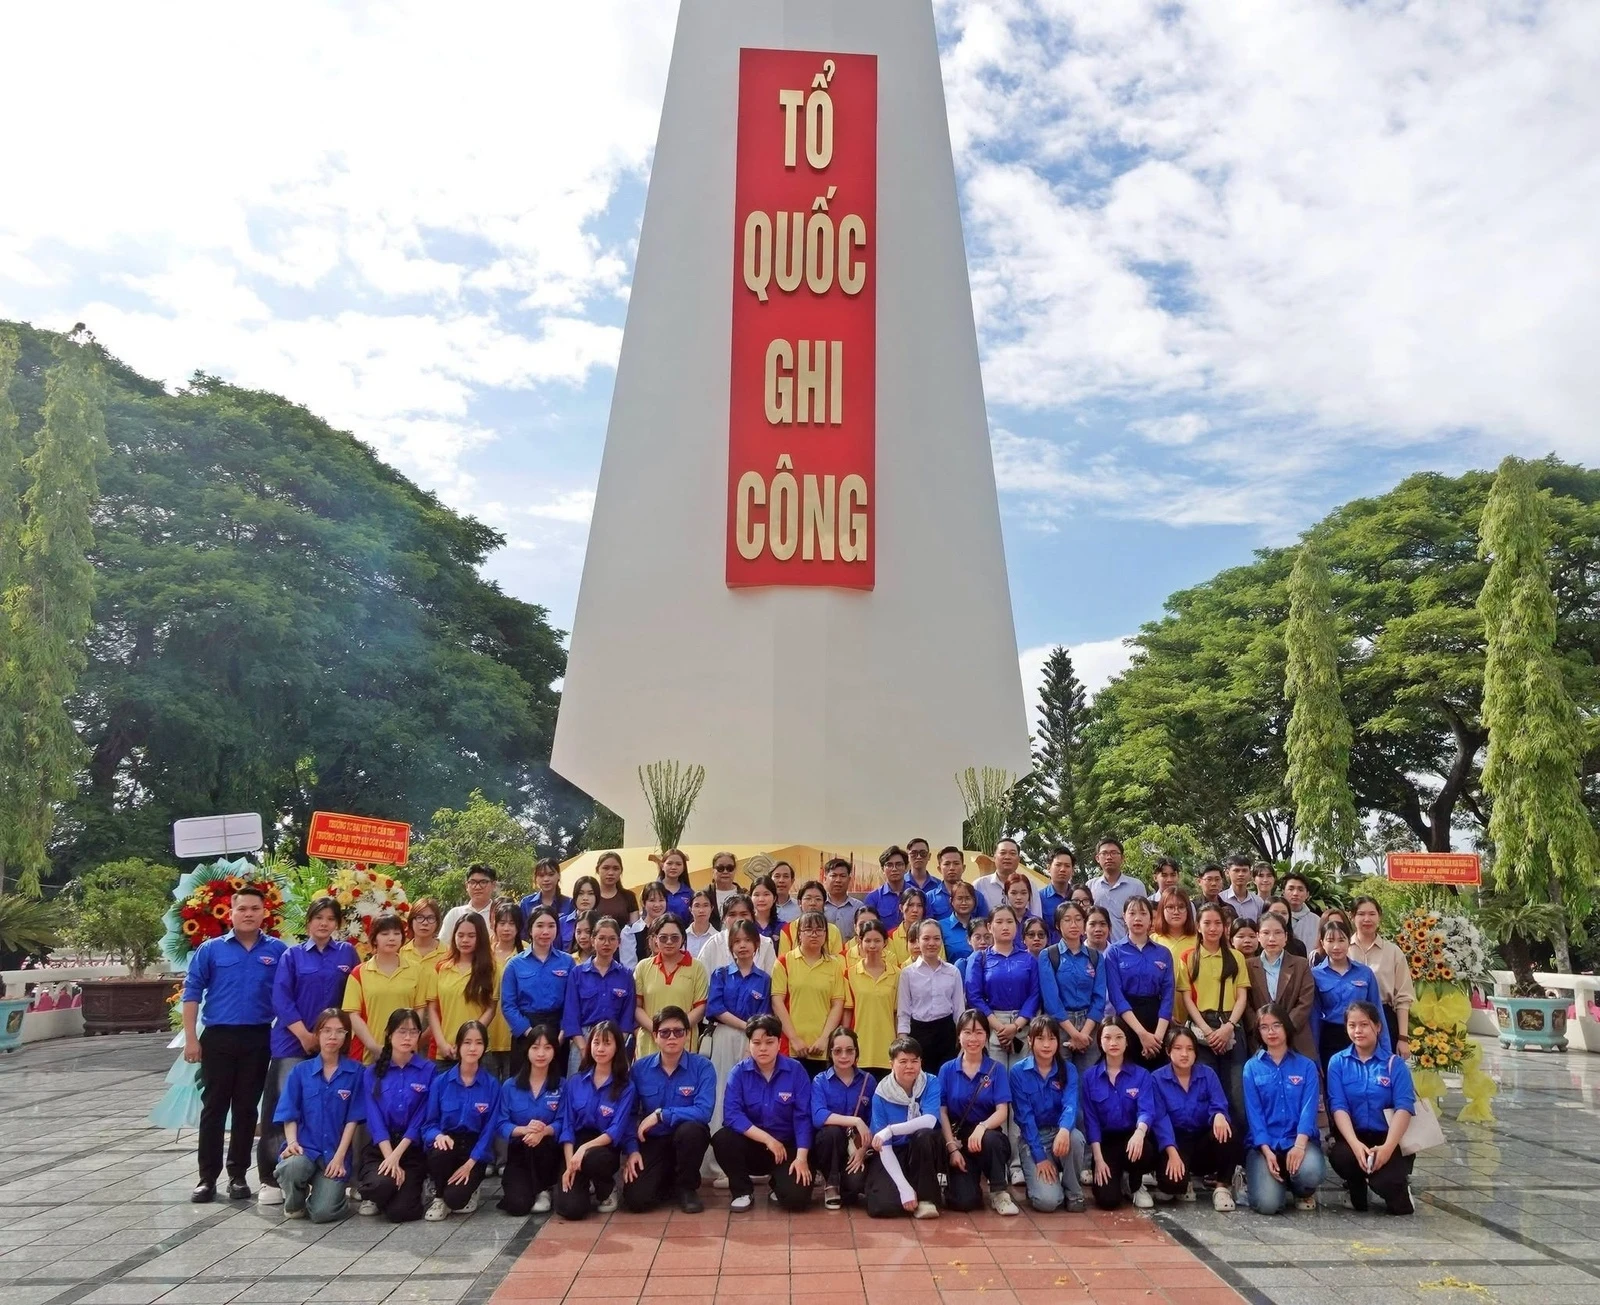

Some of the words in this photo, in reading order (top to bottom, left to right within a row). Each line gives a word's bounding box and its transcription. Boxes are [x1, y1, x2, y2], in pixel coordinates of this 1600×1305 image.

[779, 59, 836, 169] TỔ
[743, 185, 866, 302] QUỐC
[764, 338, 843, 425] GHI
[735, 453, 868, 562] CÔNG
